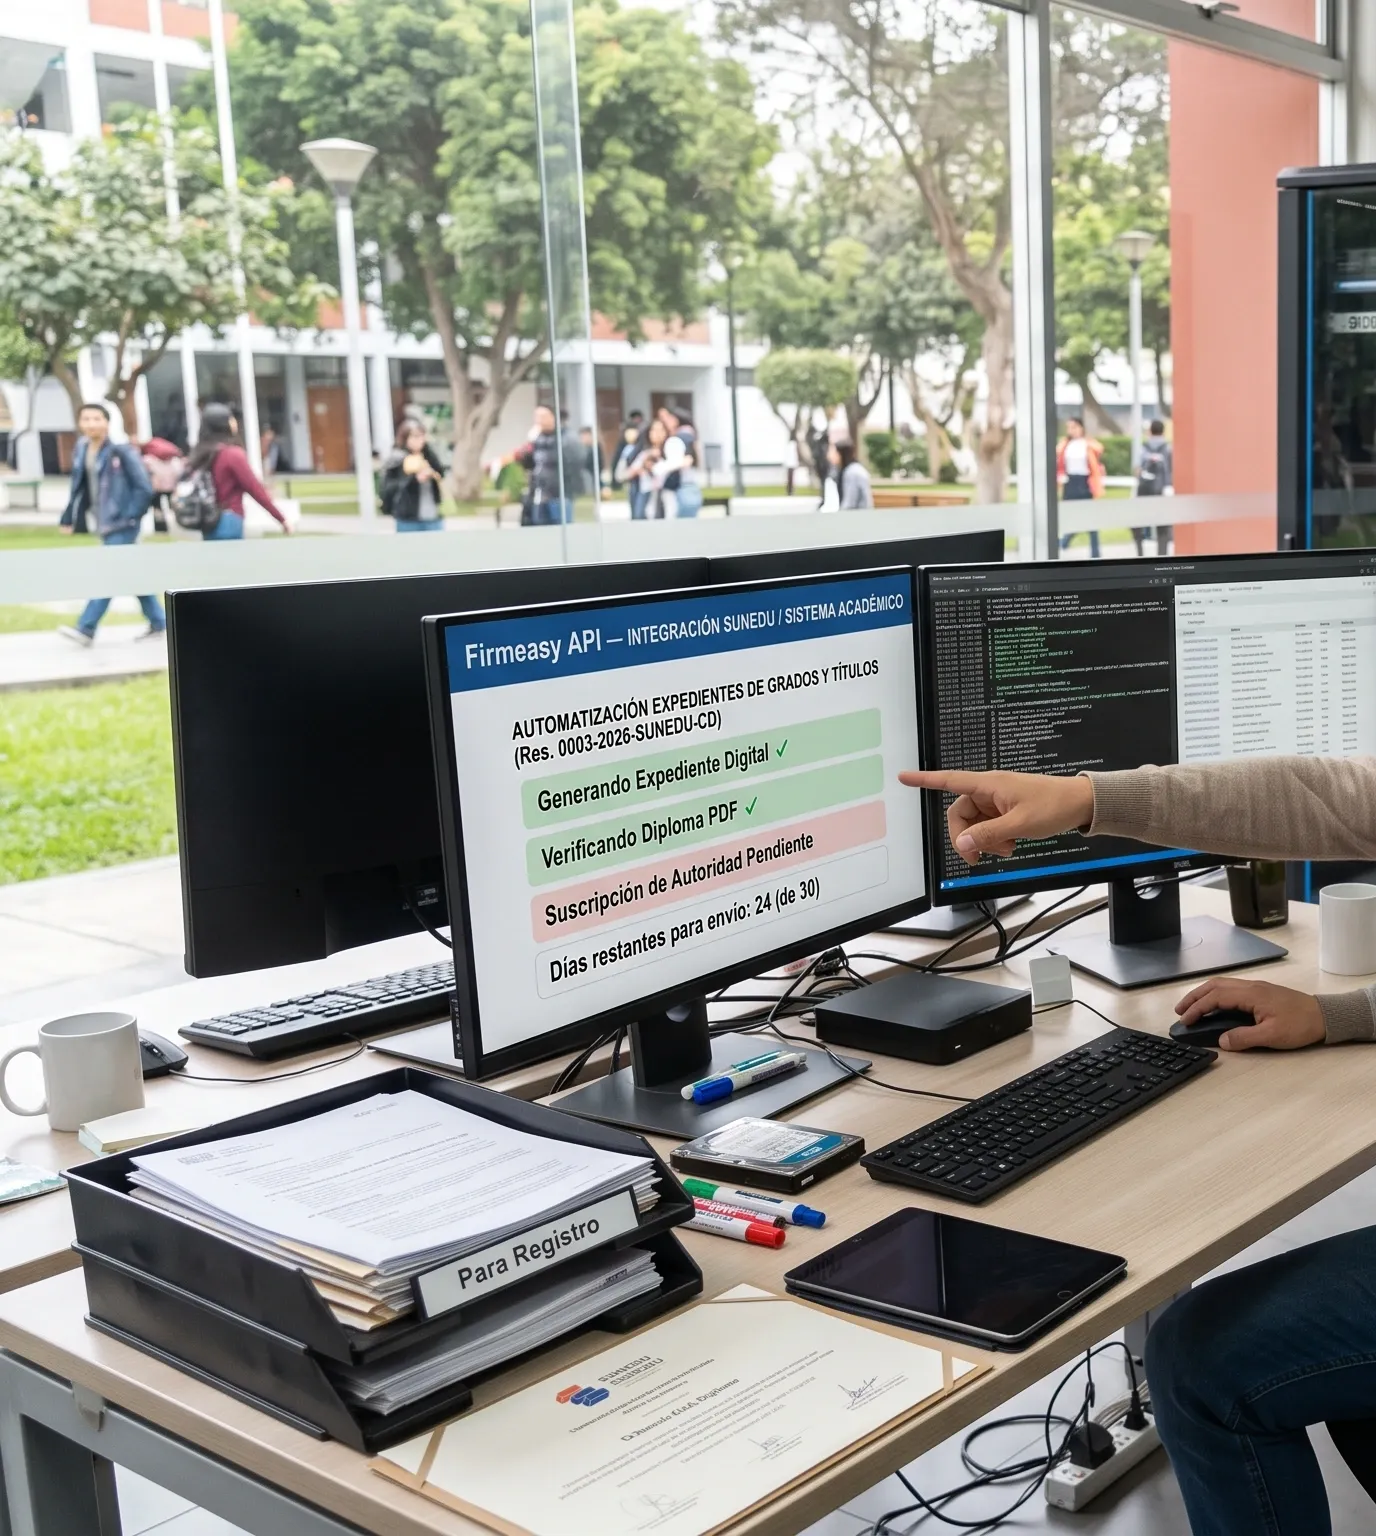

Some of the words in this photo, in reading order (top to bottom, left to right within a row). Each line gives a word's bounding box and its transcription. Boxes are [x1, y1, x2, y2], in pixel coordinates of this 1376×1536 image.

[465, 639, 562, 669] Firmeasy
[567, 628, 601, 655] API
[627, 615, 720, 646] INTEGRACIÓN
[723, 610, 775, 633] SUNEDU
[785, 602, 836, 624] SISTEMA
[838, 593, 904, 617] ACADÉMICO
[512, 696, 648, 740] AUTOMATIZACIÓN
[652, 682, 744, 715] EXPEDIENTES
[747, 679, 765, 698] DE
[767, 669, 819, 693] GRADOS
[821, 668, 830, 684] Y
[831, 659, 879, 682] TÍTULOS
[514, 743, 554, 770] (Res.
[558, 709, 722, 757] 0003-2026-SUNEDU-CD)
[537, 774, 631, 812] Generando
[635, 756, 721, 790] Expediente
[724, 742, 769, 772] Digital
[541, 828, 637, 869] Verificando
[641, 814, 704, 845] Diploma
[708, 800, 738, 826] PDF
[544, 881, 644, 926] Suscripción
[648, 874, 668, 896] de
[671, 851, 743, 890] Autoridad
[746, 832, 814, 867] Pendiente
[550, 954, 588, 983] Días
[592, 929, 666, 969] restantes
[670, 918, 704, 948] para
[707, 901, 751, 931] envío:
[755, 892, 772, 916] 24
[775, 886, 796, 913] (de
[800, 876, 821, 901] 30)
[457, 1258, 509, 1289] Para
[512, 1218, 600, 1266] Registro
